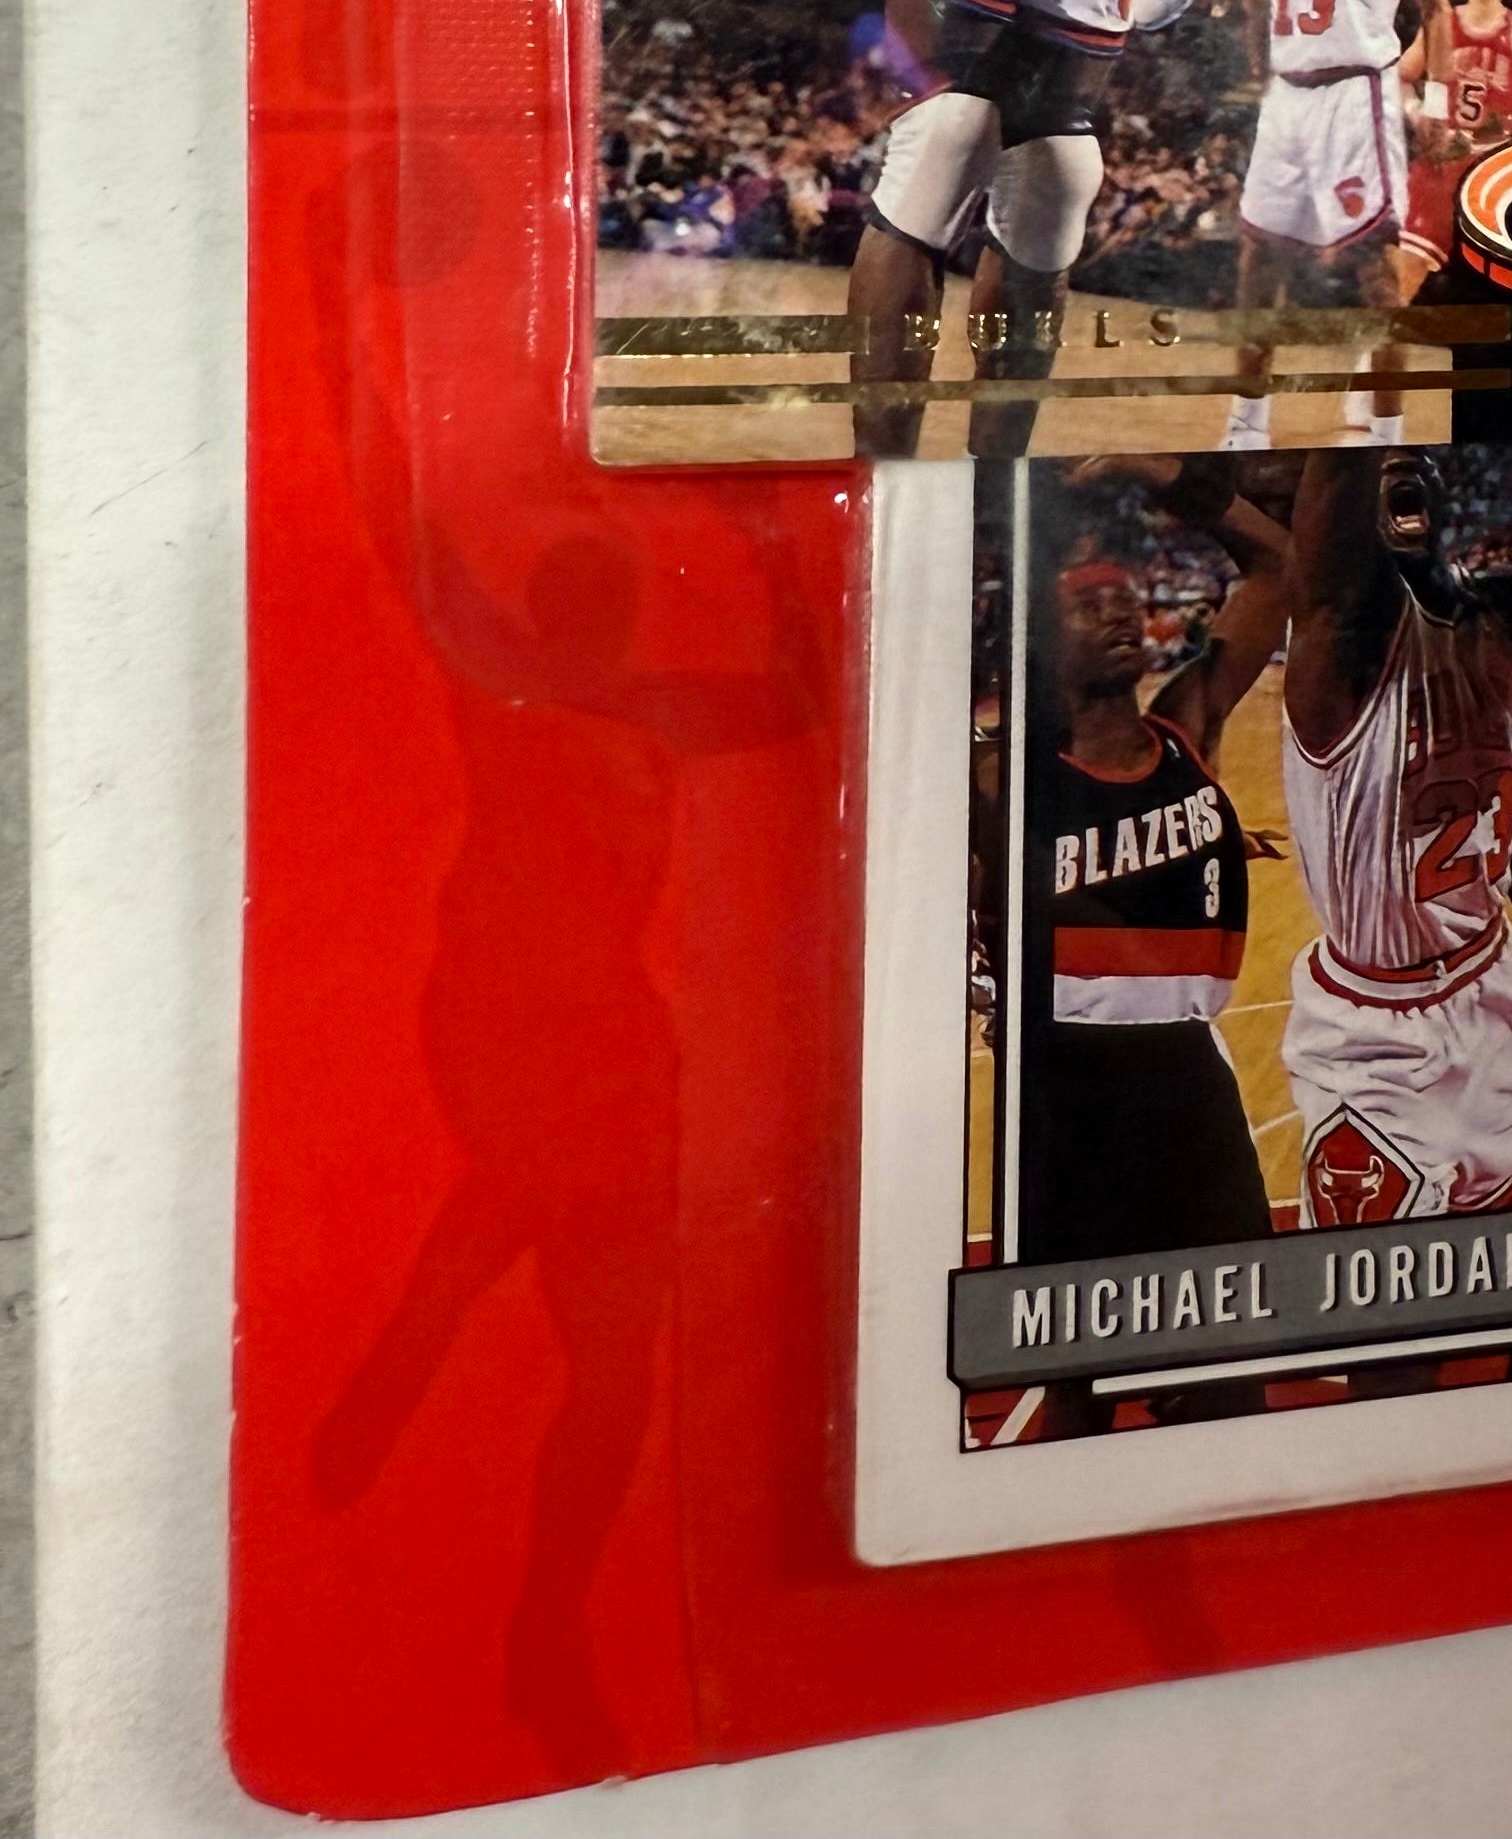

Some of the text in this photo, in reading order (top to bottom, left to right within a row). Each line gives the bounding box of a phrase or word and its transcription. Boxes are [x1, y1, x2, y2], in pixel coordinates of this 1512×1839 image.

[1456, 80, 1487, 126] 5
[1055, 785, 1223, 894] BLAZERS
[1012, 1262, 1273, 1348] MICHAEL
